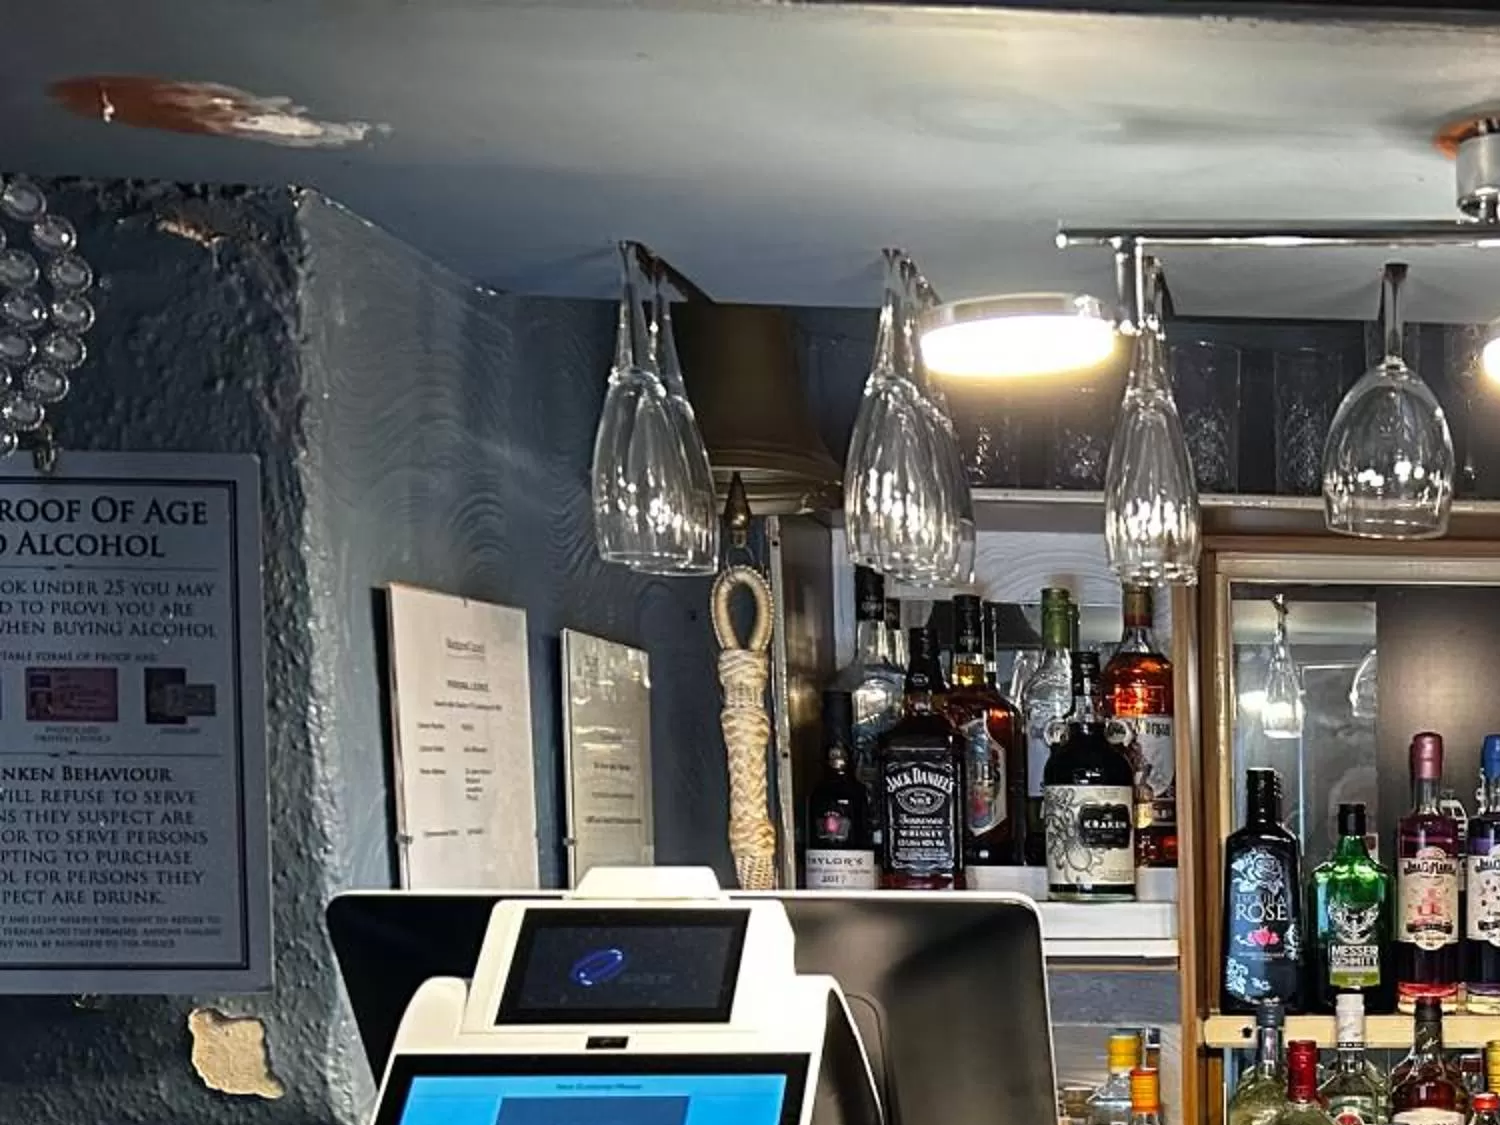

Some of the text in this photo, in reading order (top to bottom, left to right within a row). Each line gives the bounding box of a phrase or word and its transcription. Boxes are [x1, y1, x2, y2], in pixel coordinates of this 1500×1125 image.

[0, 498, 81, 523] ROOF
[1, 580, 215, 598] OK UNDER 25 YOU MAY
[21, 602, 43, 615] TO
[51, 602, 109, 617] PROVE
[116, 602, 155, 616] YOU
[159, 602, 194, 616] ARE
[53, 621, 123, 637] BUYING
[129, 622, 217, 639] ALCOHOL
[1, 767, 55, 782] NKEN
[41, 789, 103, 804] REFUSE
[114, 790, 136, 804] TO
[144, 791, 197, 805] SERVE
[25, 810, 71, 824] THEY
[77, 810, 154, 825] SUSPECT
[160, 811, 194, 825] ARE
[1083, 820, 1128, 829] KRAKEN
[36, 830, 58, 844] TO
[67, 830, 119, 844] SERVE
[127, 831, 208, 845] PERSONS
[0, 851, 193, 865] PTING TO PURCHASE
[25, 871, 61, 885] FOR
[67, 871, 149, 885] PERSONS
[156, 871, 205, 885] THEY
[3, 890, 45, 905] PECT
[51, 890, 84, 905] ARE
[1236, 903, 1287, 922] ROSE
